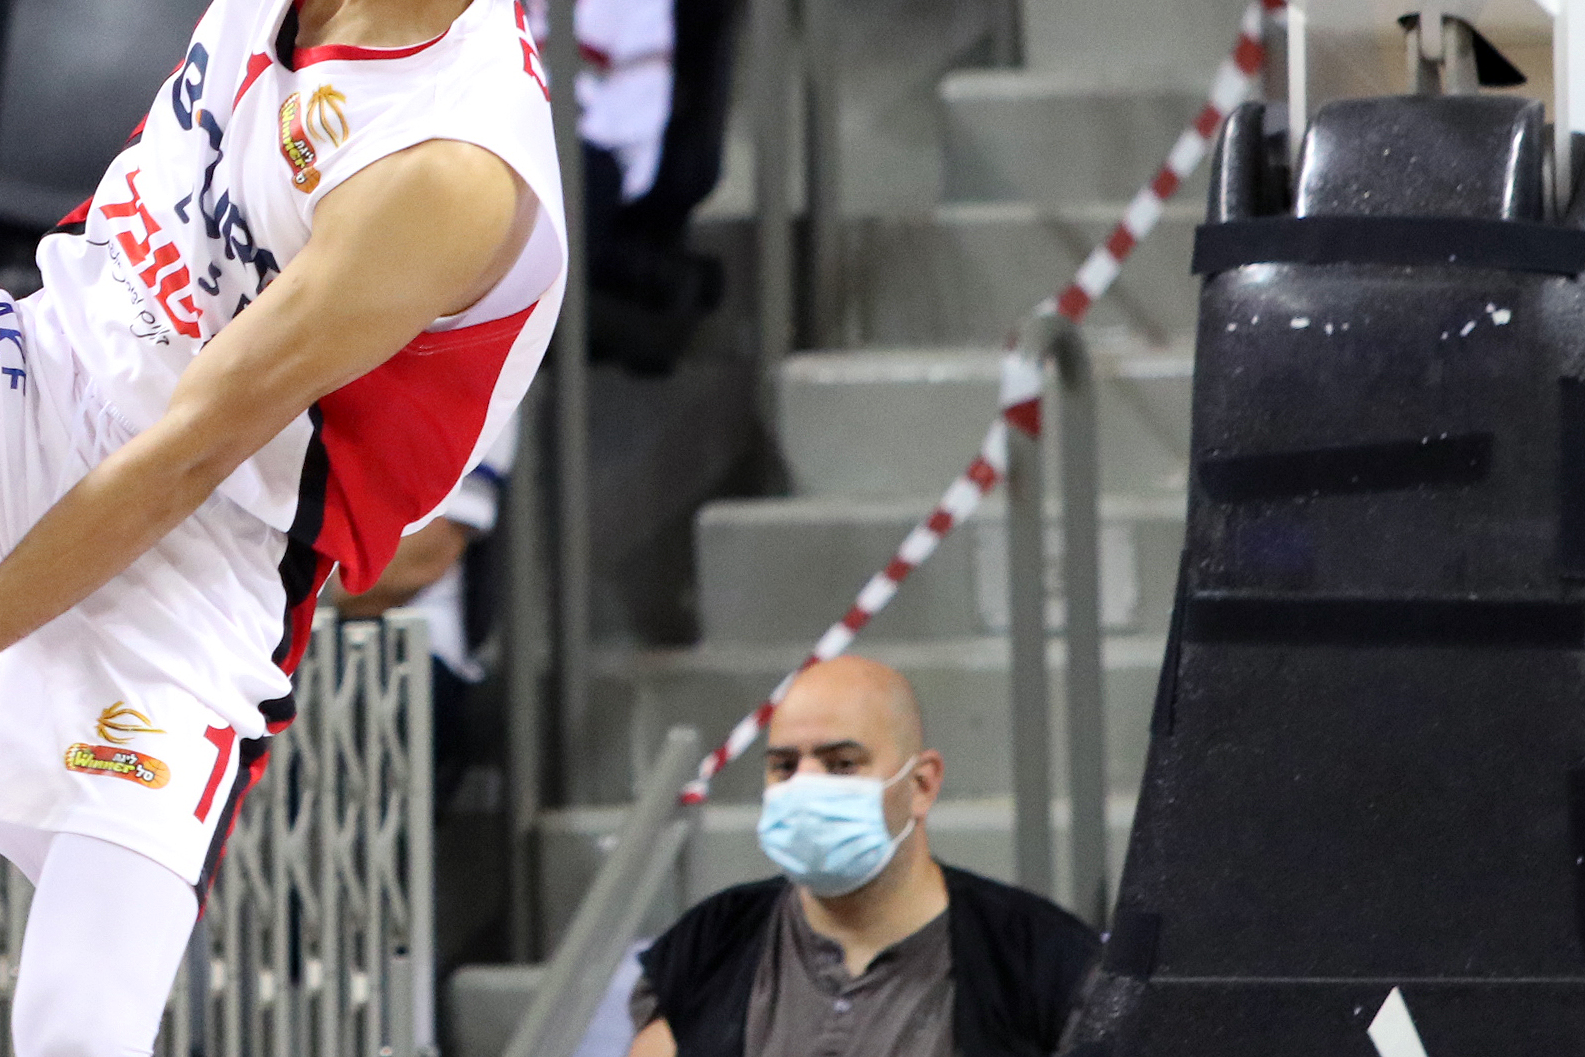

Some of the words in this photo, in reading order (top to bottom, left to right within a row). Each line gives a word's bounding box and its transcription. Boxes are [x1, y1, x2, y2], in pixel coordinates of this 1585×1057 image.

[282, 102, 306, 169] Winner
[74, 750, 136, 774] Winner
[136, 764, 155, 782] סל
